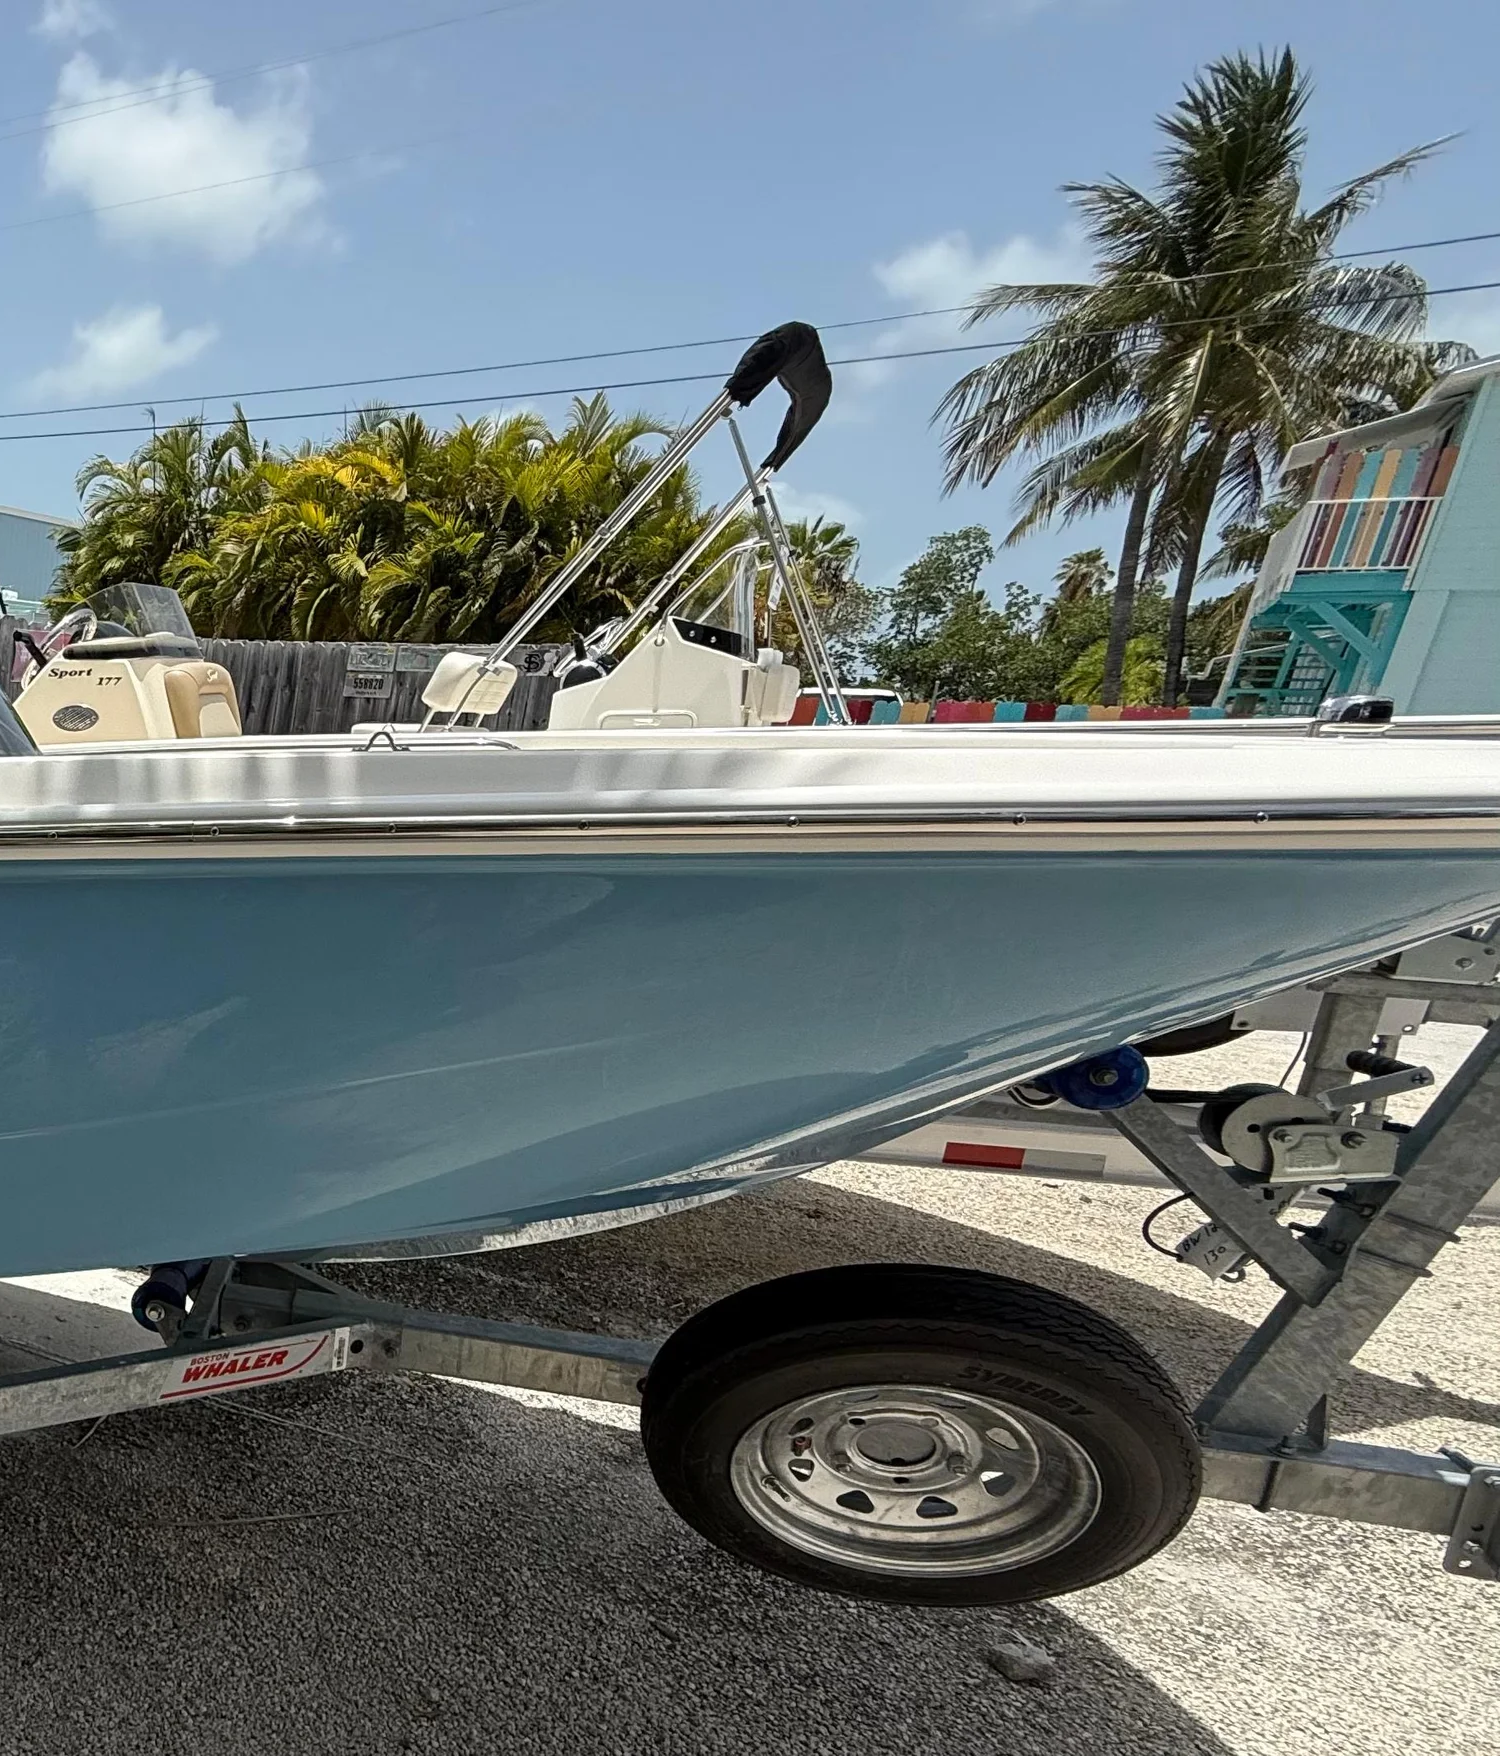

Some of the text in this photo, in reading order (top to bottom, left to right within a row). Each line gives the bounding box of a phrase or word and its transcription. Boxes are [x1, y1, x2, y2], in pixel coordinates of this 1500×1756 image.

[48, 667, 123, 687] Sport 177
[1203, 1245, 1227, 1266] 130
[181, 1350, 290, 1384] WHALER
[190, 1352, 230, 1367] BOSTON
[957, 1363, 1096, 1416] SYNERGY
